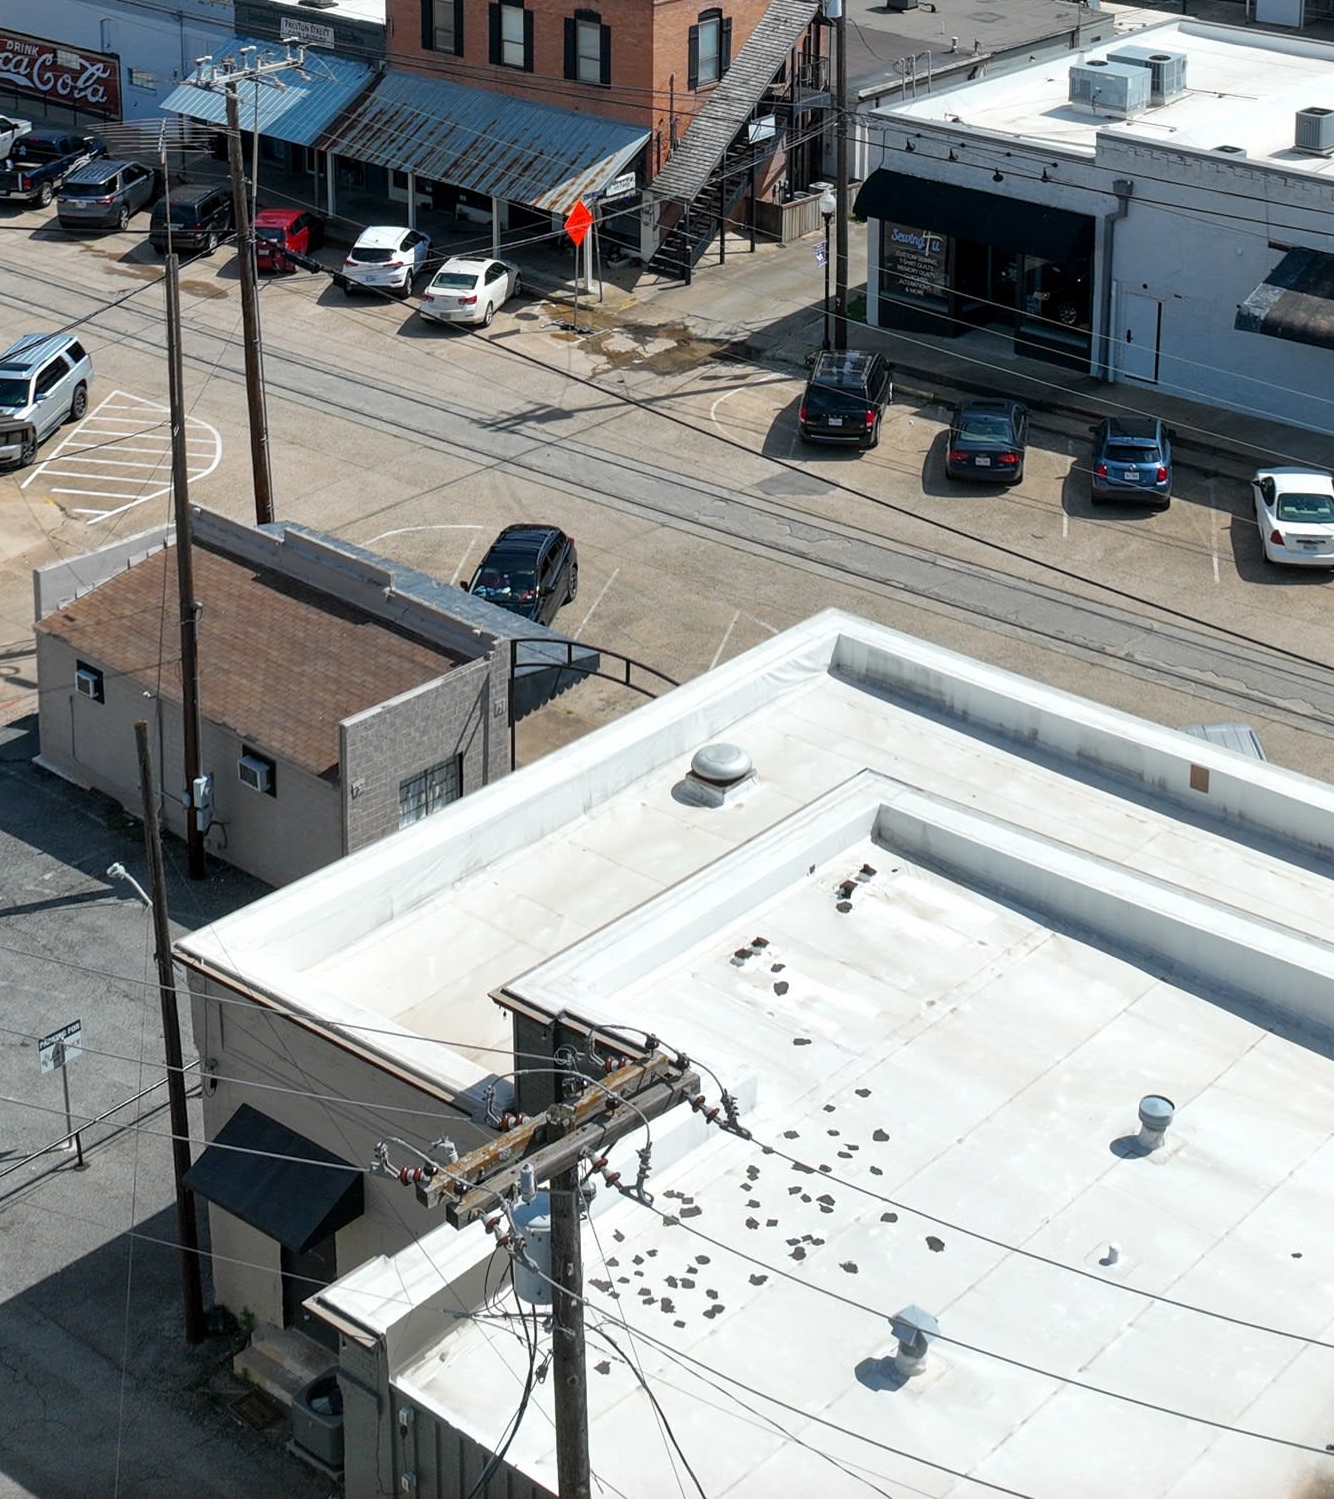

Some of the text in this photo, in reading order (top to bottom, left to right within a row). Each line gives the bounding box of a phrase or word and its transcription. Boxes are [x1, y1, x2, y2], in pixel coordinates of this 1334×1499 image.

[6, 39, 40, 57] DRINK
[33, 53, 111, 103] Cola
[892, 229, 925, 249] Sewing
[67, 1022, 80, 1034] FOR
